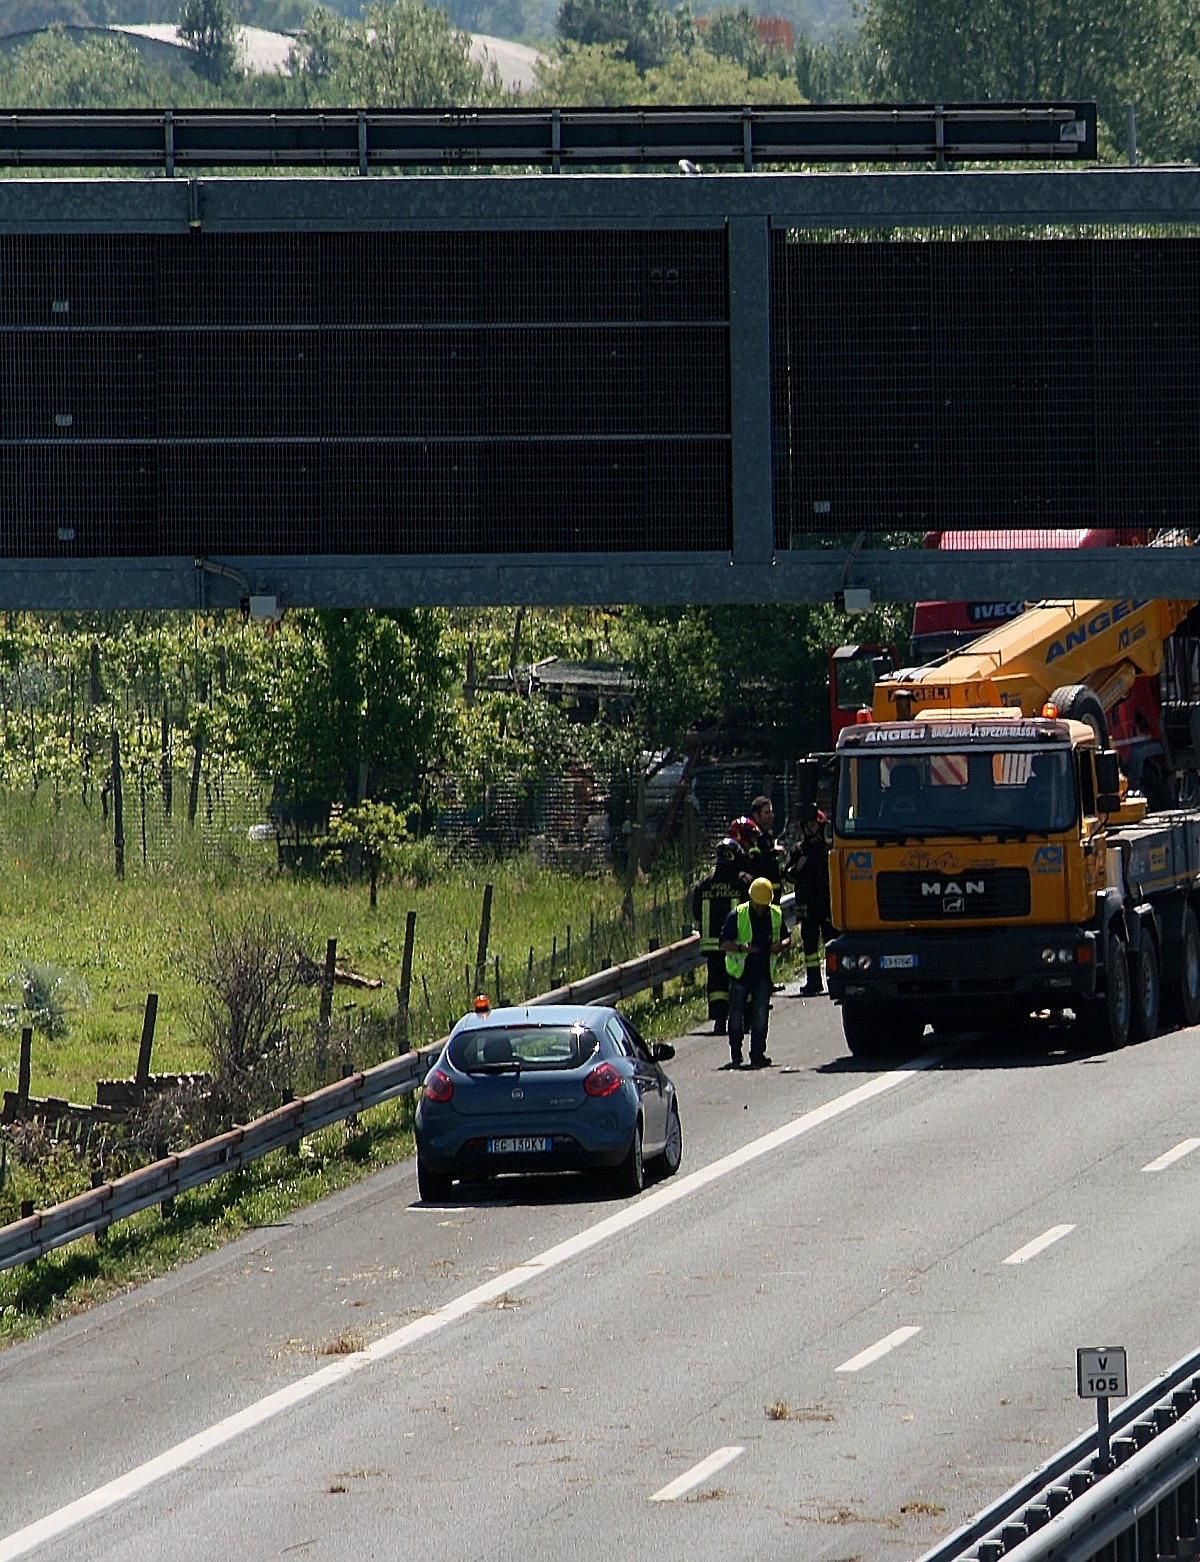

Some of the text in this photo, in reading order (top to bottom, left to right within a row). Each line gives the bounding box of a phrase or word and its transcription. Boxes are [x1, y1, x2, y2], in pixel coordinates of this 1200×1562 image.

[865, 727, 926, 742] ANGELI
[921, 880, 985, 896] MAN
[1098, 1357, 1108, 1370] V
[1088, 1378, 1118, 1392] 105
